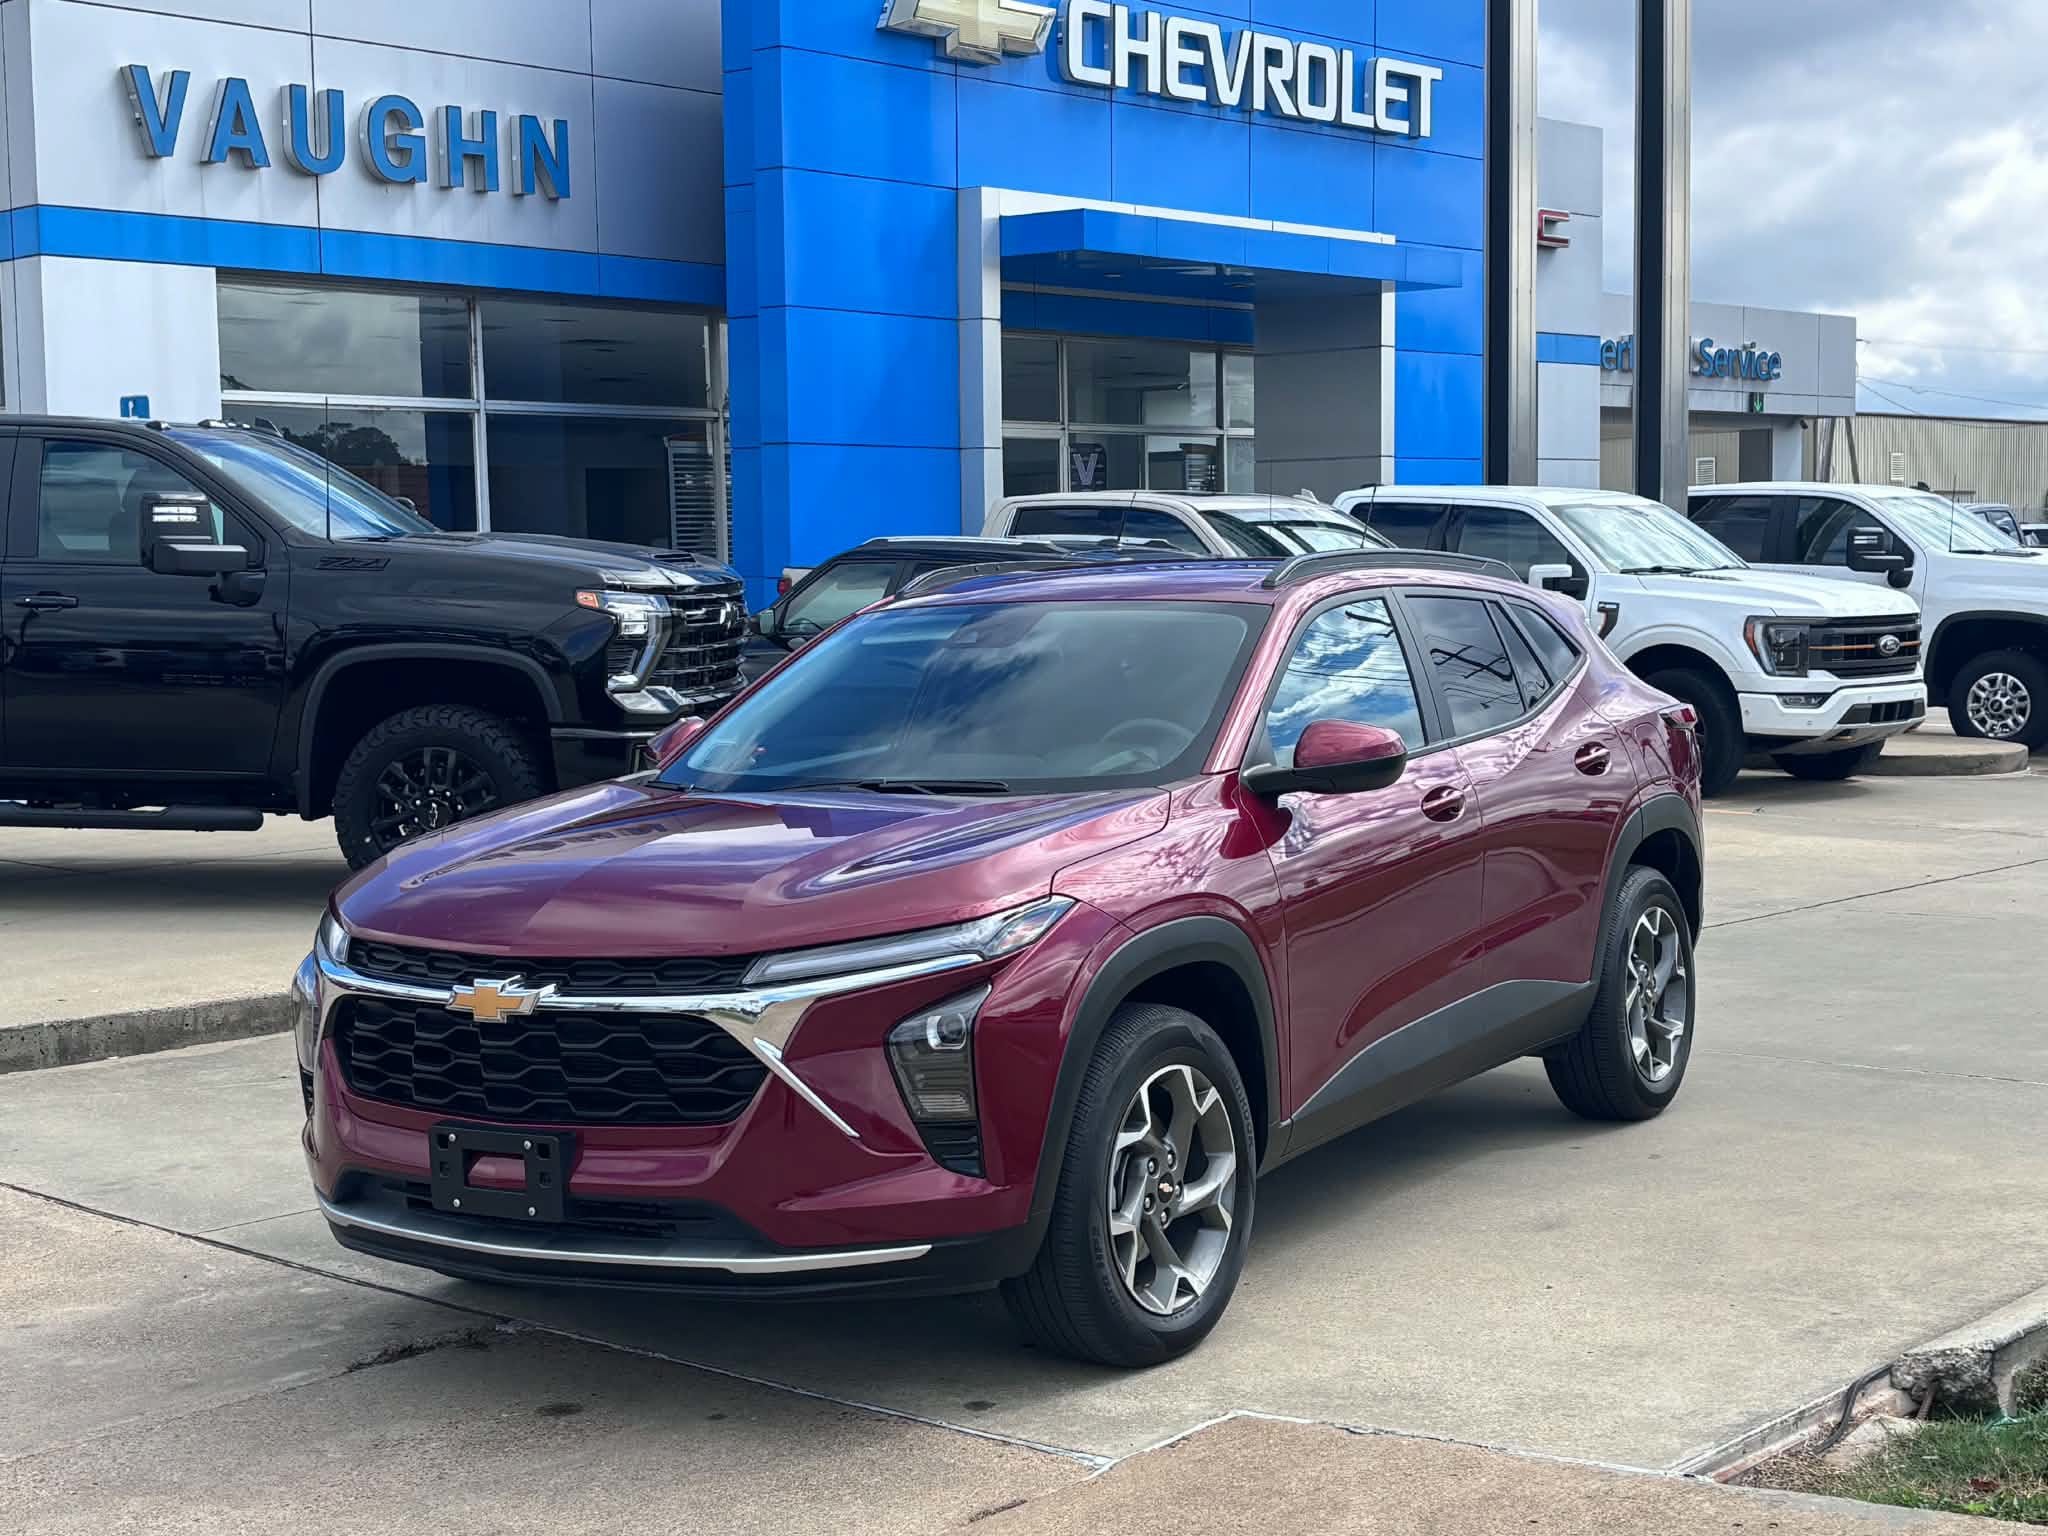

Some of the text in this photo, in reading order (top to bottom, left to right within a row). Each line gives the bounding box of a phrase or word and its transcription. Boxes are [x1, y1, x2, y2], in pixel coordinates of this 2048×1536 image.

[122, 64, 571, 200] VAUGHN
[1063, 0, 1443, 138] CHEVROLET
[1699, 338, 1782, 380] Service
